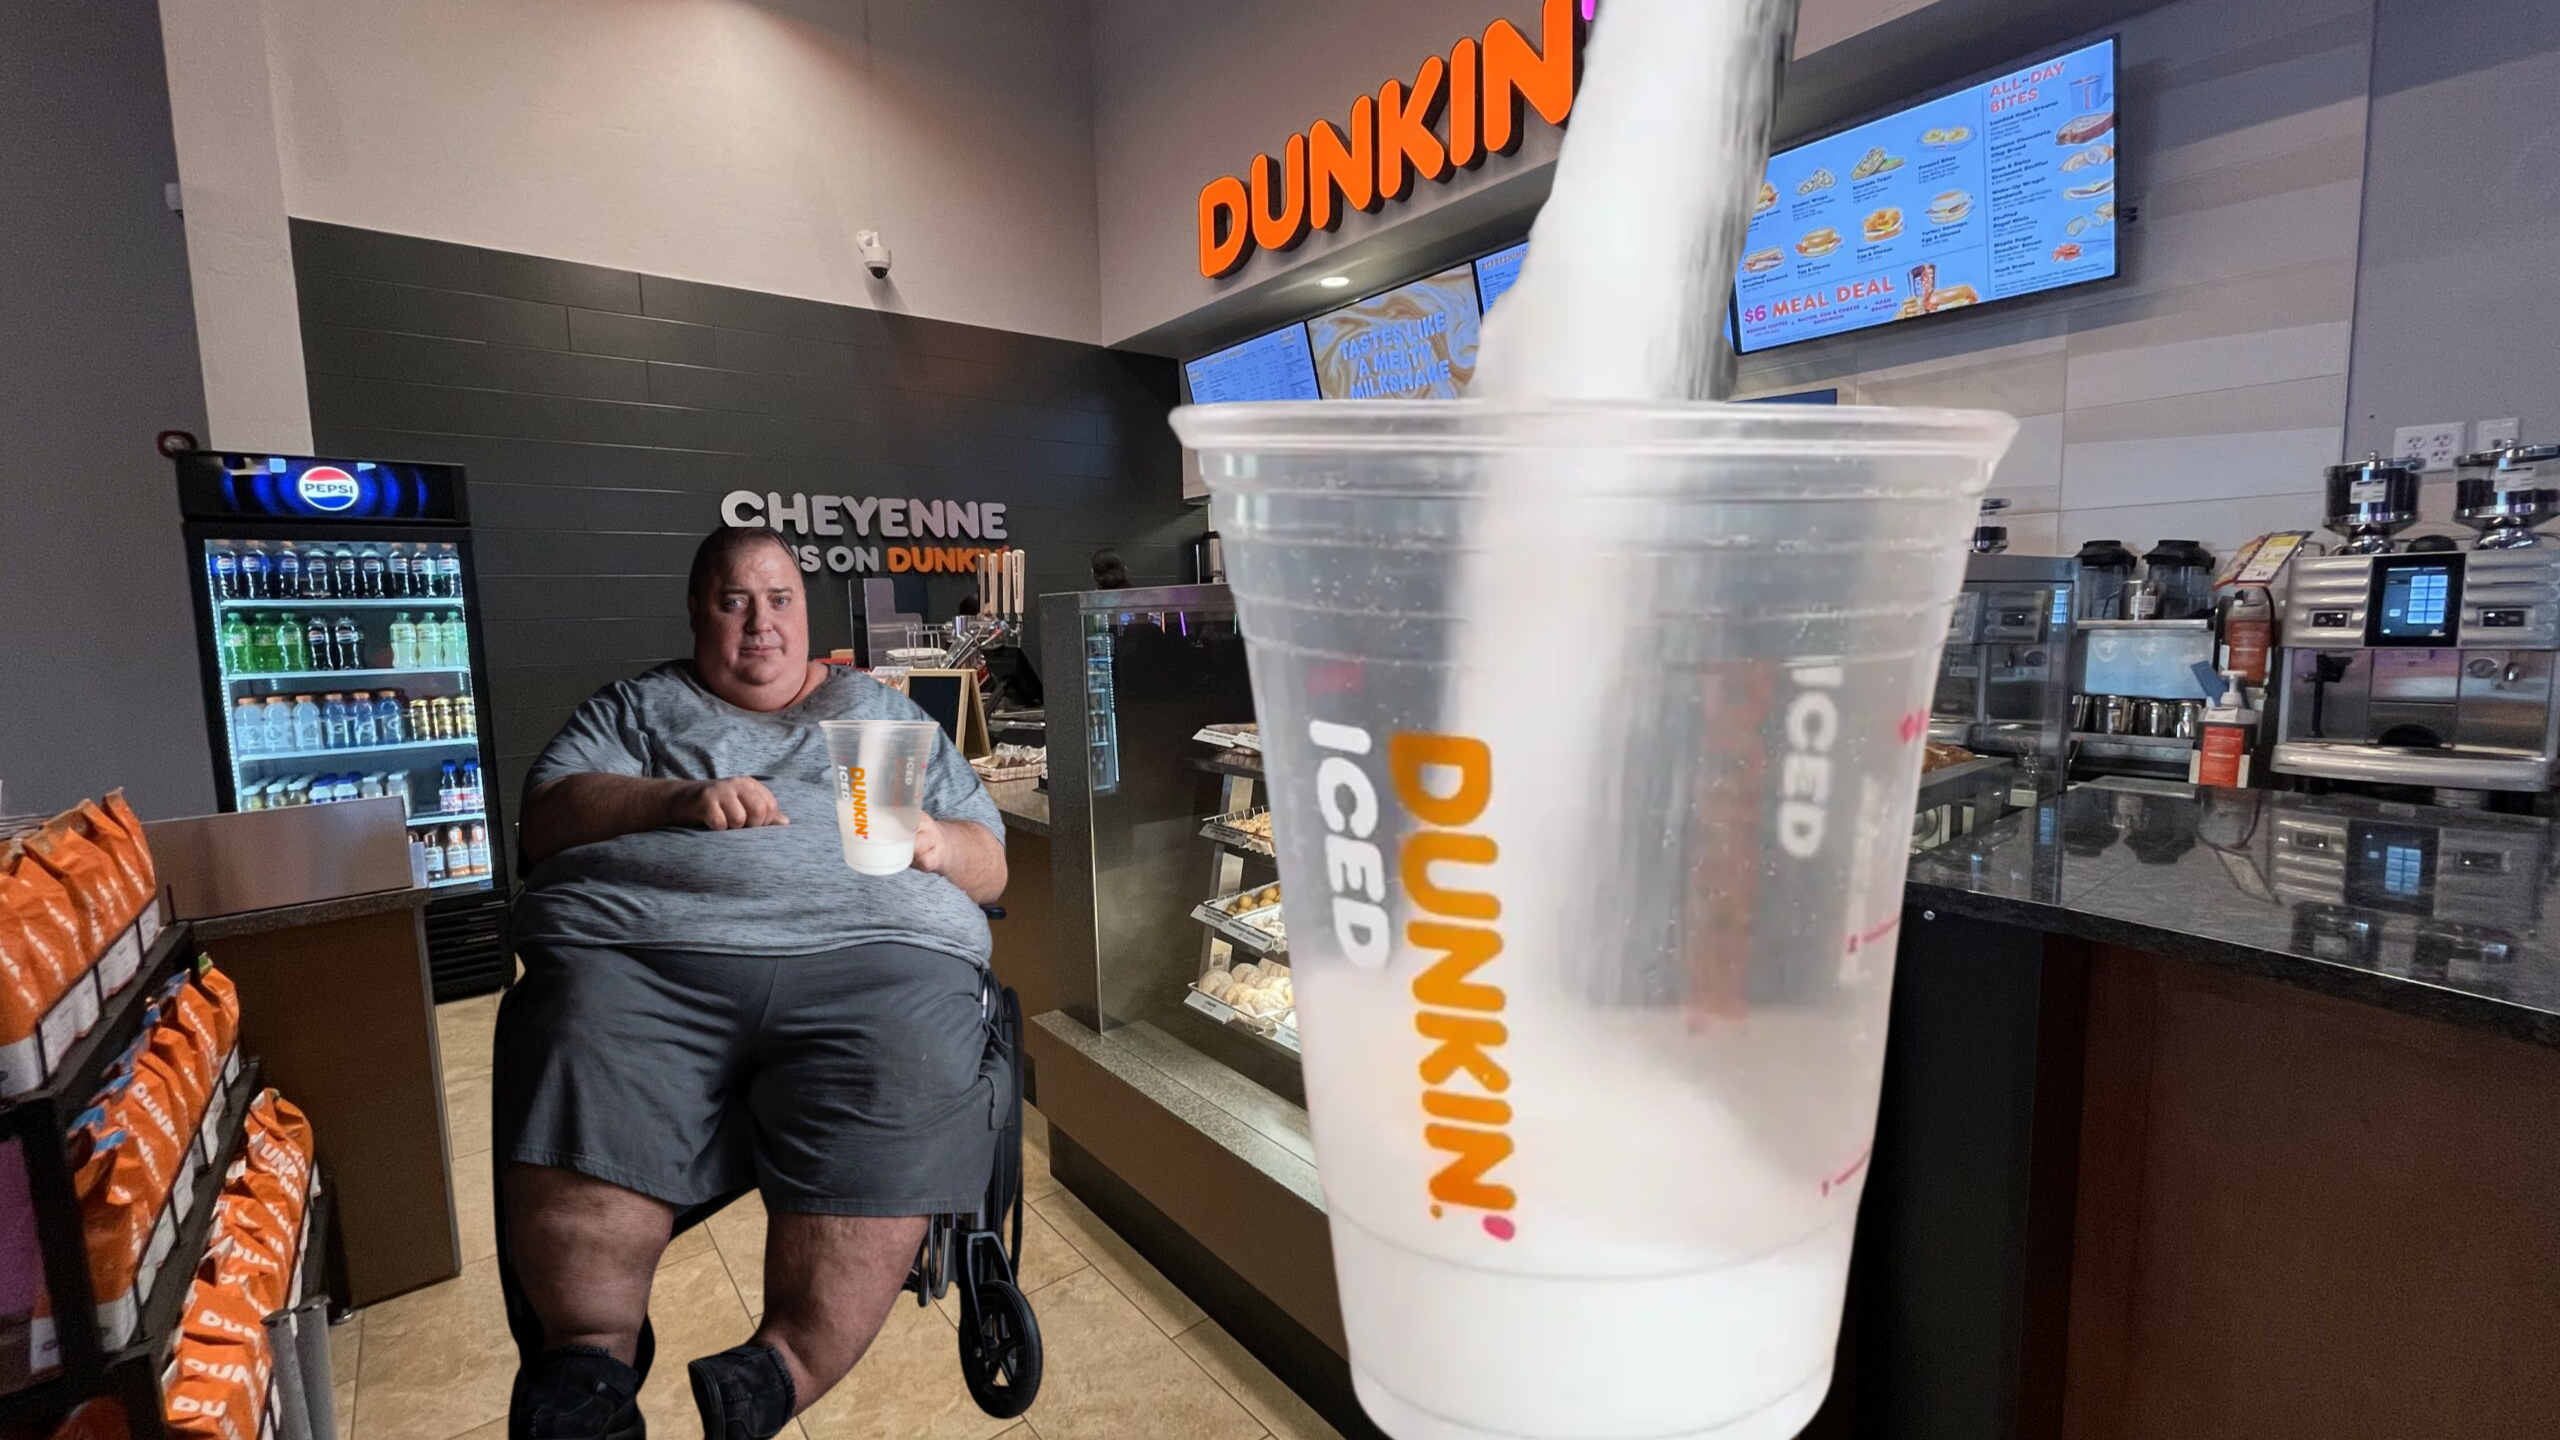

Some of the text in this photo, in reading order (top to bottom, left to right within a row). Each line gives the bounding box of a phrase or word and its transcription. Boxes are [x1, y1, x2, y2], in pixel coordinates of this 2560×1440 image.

[1990, 61, 2065, 98] ALL-DAY
[1990, 87, 2038, 113] BITES
[1744, 304, 1767, 325] $6
[1772, 291, 1831, 319] MEAL
[1835, 275, 1896, 303] DEAL
[1339, 311, 1446, 361] TASTES LIKE
[1350, 359, 1452, 400] MILKSHAKE
[1359, 341, 1432, 380] A MELTY
[304, 483, 354, 494] PEPSI
[720, 489, 1008, 540] CHEYENNE
[826, 546, 880, 573] ON
[838, 765, 850, 801] ICED
[1308, 719, 1391, 969] ICED
